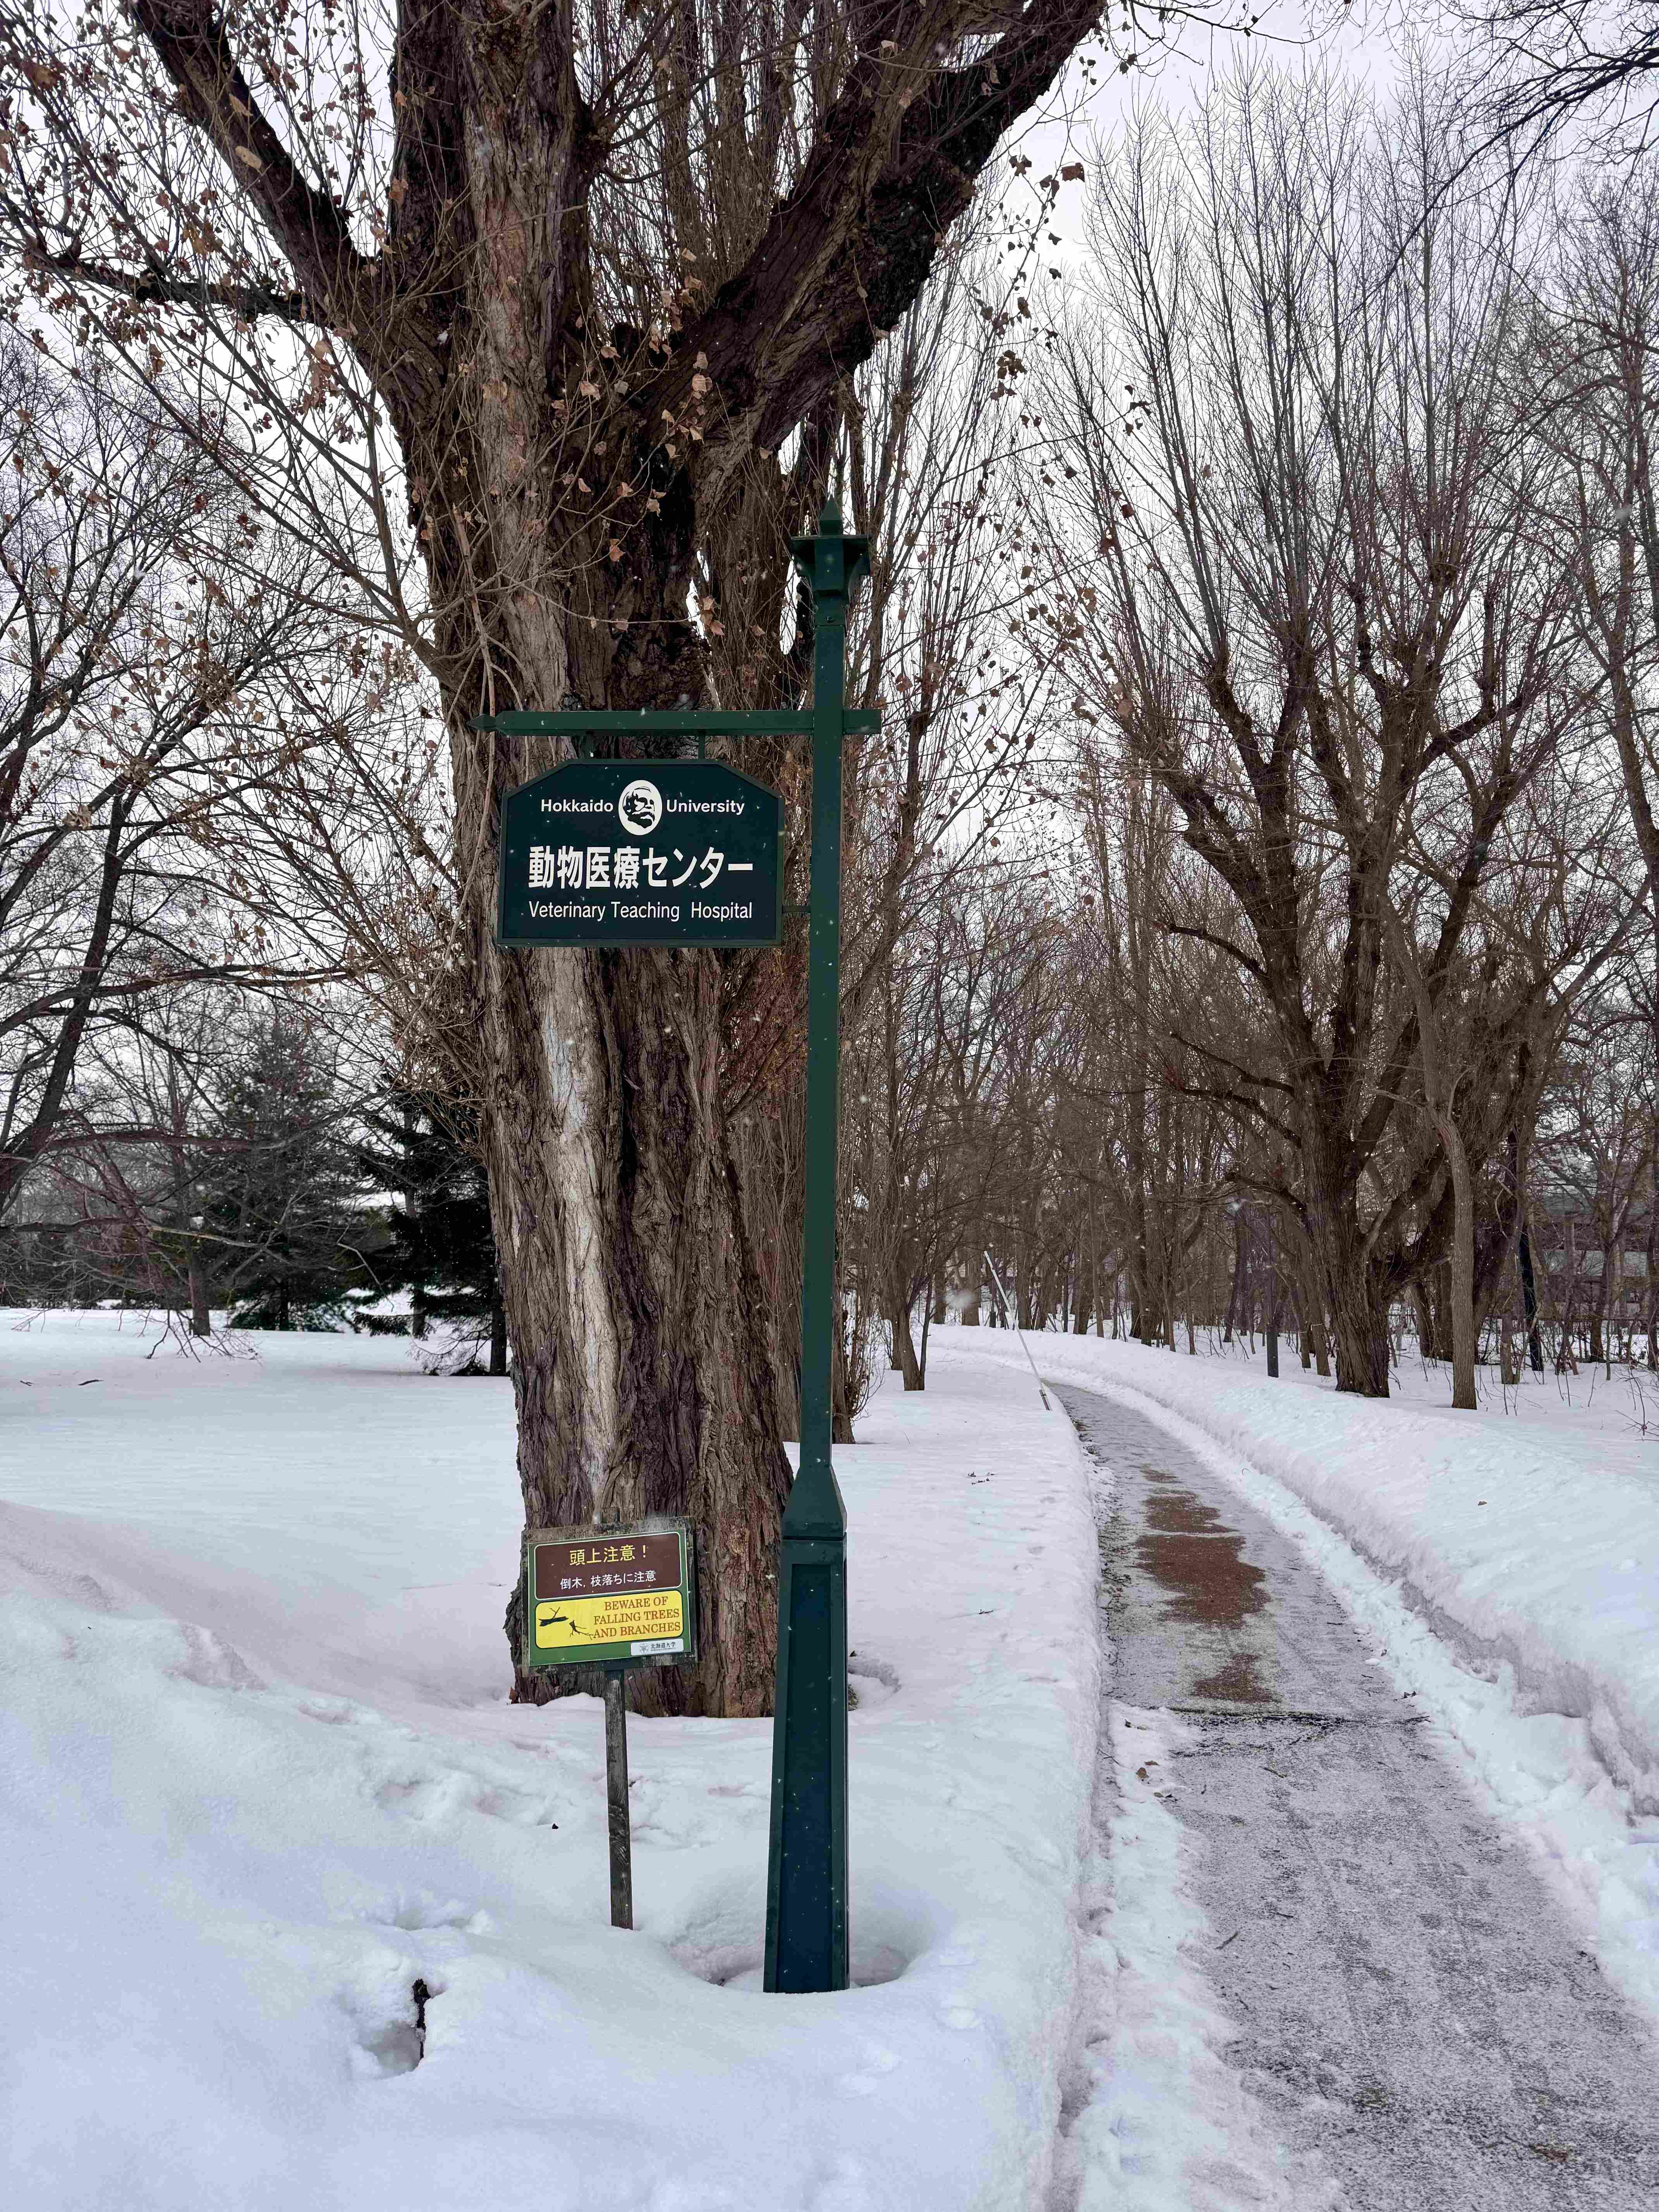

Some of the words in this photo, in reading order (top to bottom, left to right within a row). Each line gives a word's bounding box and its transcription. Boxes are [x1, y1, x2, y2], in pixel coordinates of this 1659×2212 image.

[541, 799, 613, 812] Hokkaido
[666, 800, 745, 814] University
[528, 845, 753, 889] 動物医療センター
[529, 901, 605, 922] Veterinary
[611, 901, 679, 922] Teaching
[691, 902, 752, 922] Hospital
[569, 1544, 647, 1566] 頭上注意！
[604, 1597, 650, 1611] BEWARE
[653, 1596, 668, 1606] OF
[594, 1612, 641, 1625] FALLING
[644, 1609, 680, 1620] TREES
[594, 1627, 617, 1638] AND
[620, 1621, 681, 1636] BRANCHES
